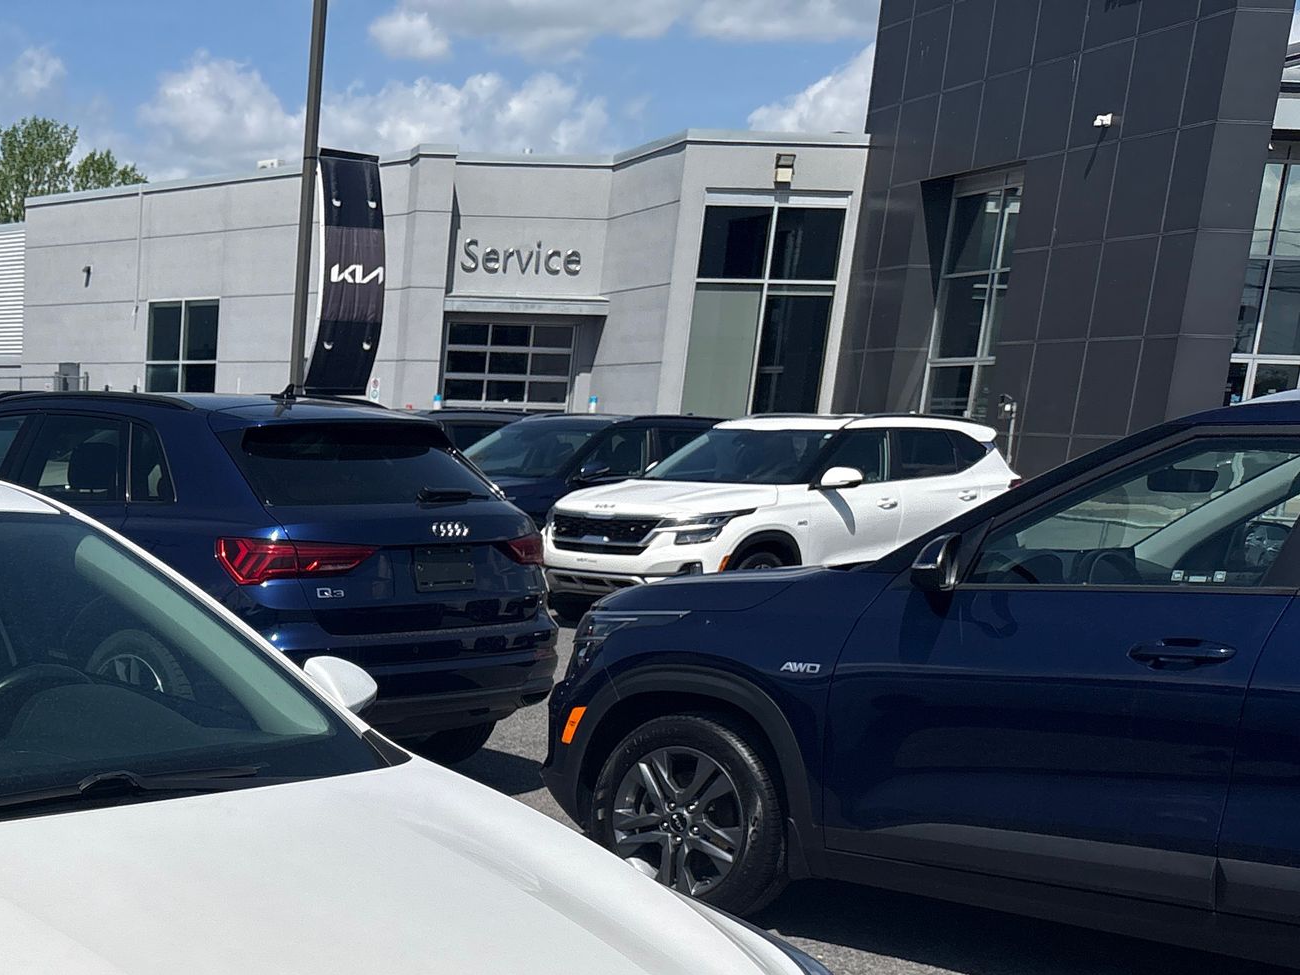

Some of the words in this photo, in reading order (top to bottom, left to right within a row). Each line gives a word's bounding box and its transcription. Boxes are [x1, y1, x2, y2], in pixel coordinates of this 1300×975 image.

[460, 238, 582, 276] Service
[330, 263, 384, 285] KIA
[316, 587, 345, 599] Q3
[780, 661, 820, 673] AWD
